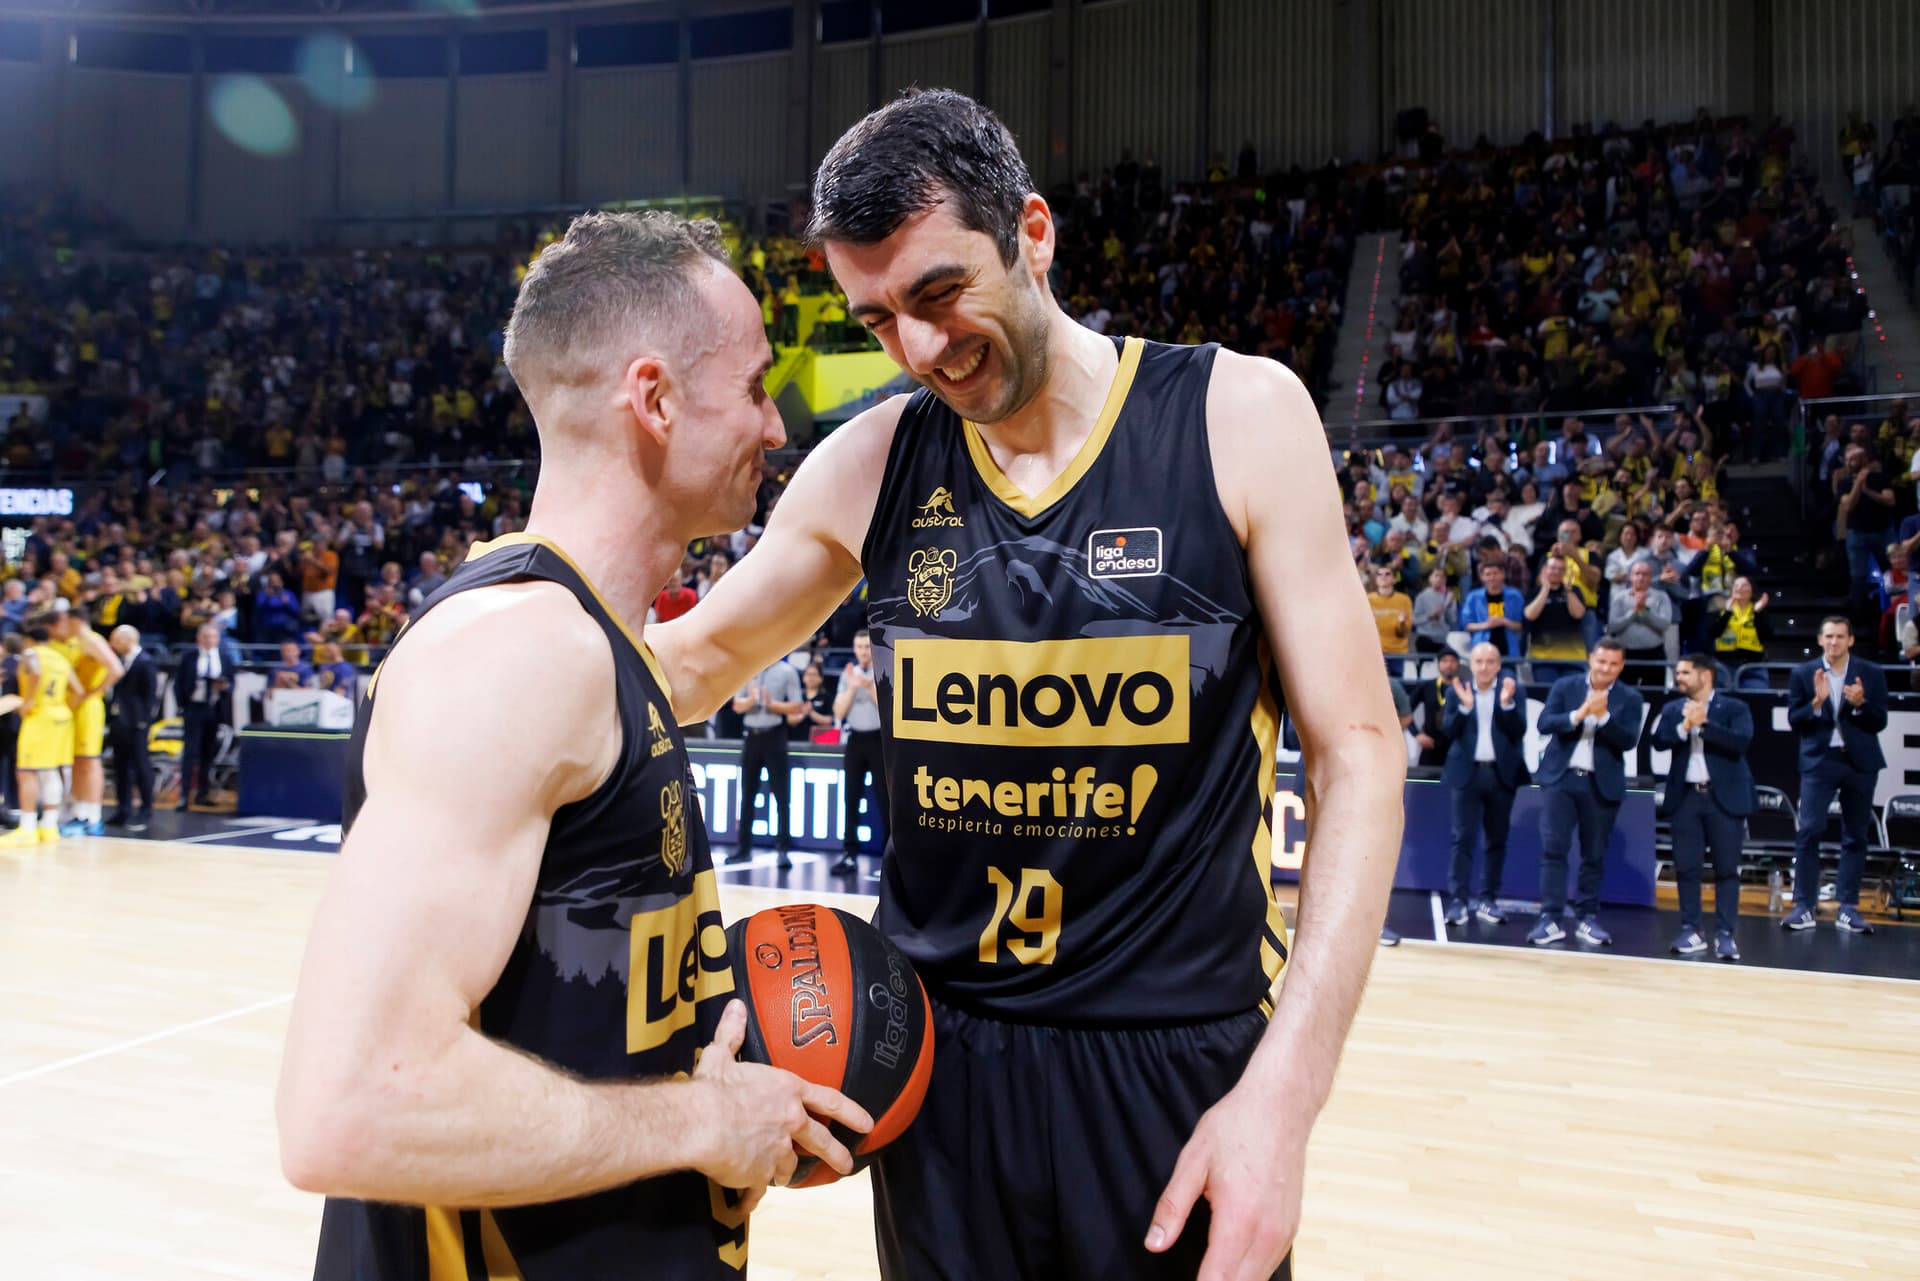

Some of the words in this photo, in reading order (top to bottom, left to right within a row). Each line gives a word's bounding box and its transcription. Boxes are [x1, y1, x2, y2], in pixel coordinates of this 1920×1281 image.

[911, 514, 964, 528] austral
[1096, 545, 1123, 560] liga
[1096, 557, 1156, 571] endesa
[901, 657, 1174, 729] Lenovo
[918, 811, 1002, 836] despierta
[1013, 822, 1121, 839] emociones
[978, 865, 1063, 965] 19
